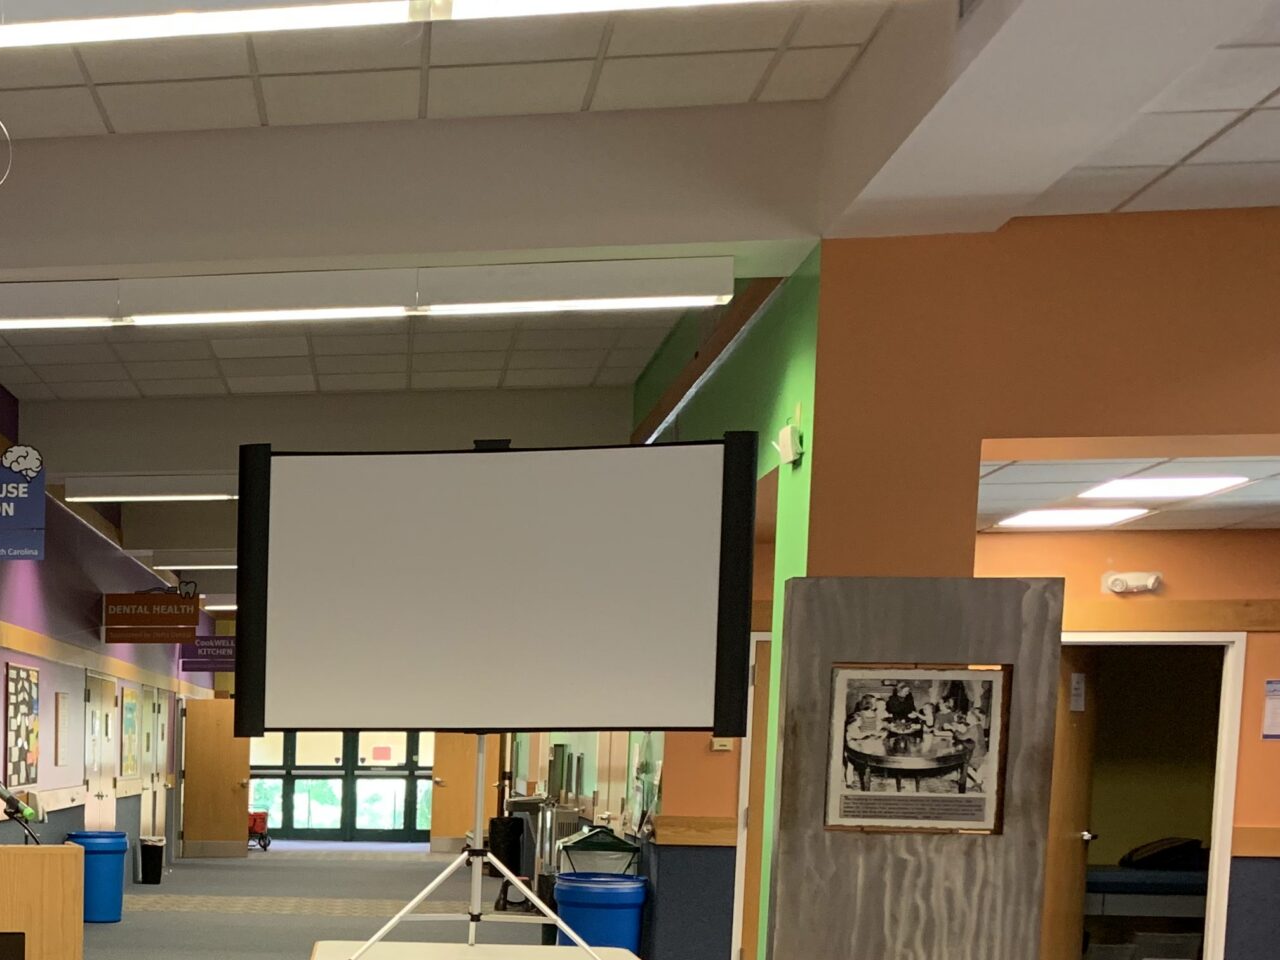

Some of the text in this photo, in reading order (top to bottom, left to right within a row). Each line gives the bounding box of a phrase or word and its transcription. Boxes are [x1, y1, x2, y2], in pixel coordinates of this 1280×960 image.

[7, 547, 39, 556] Carolina
[108, 605, 194, 614] DENTAL HEALTH
[198, 648, 233, 656] KITCHEN
